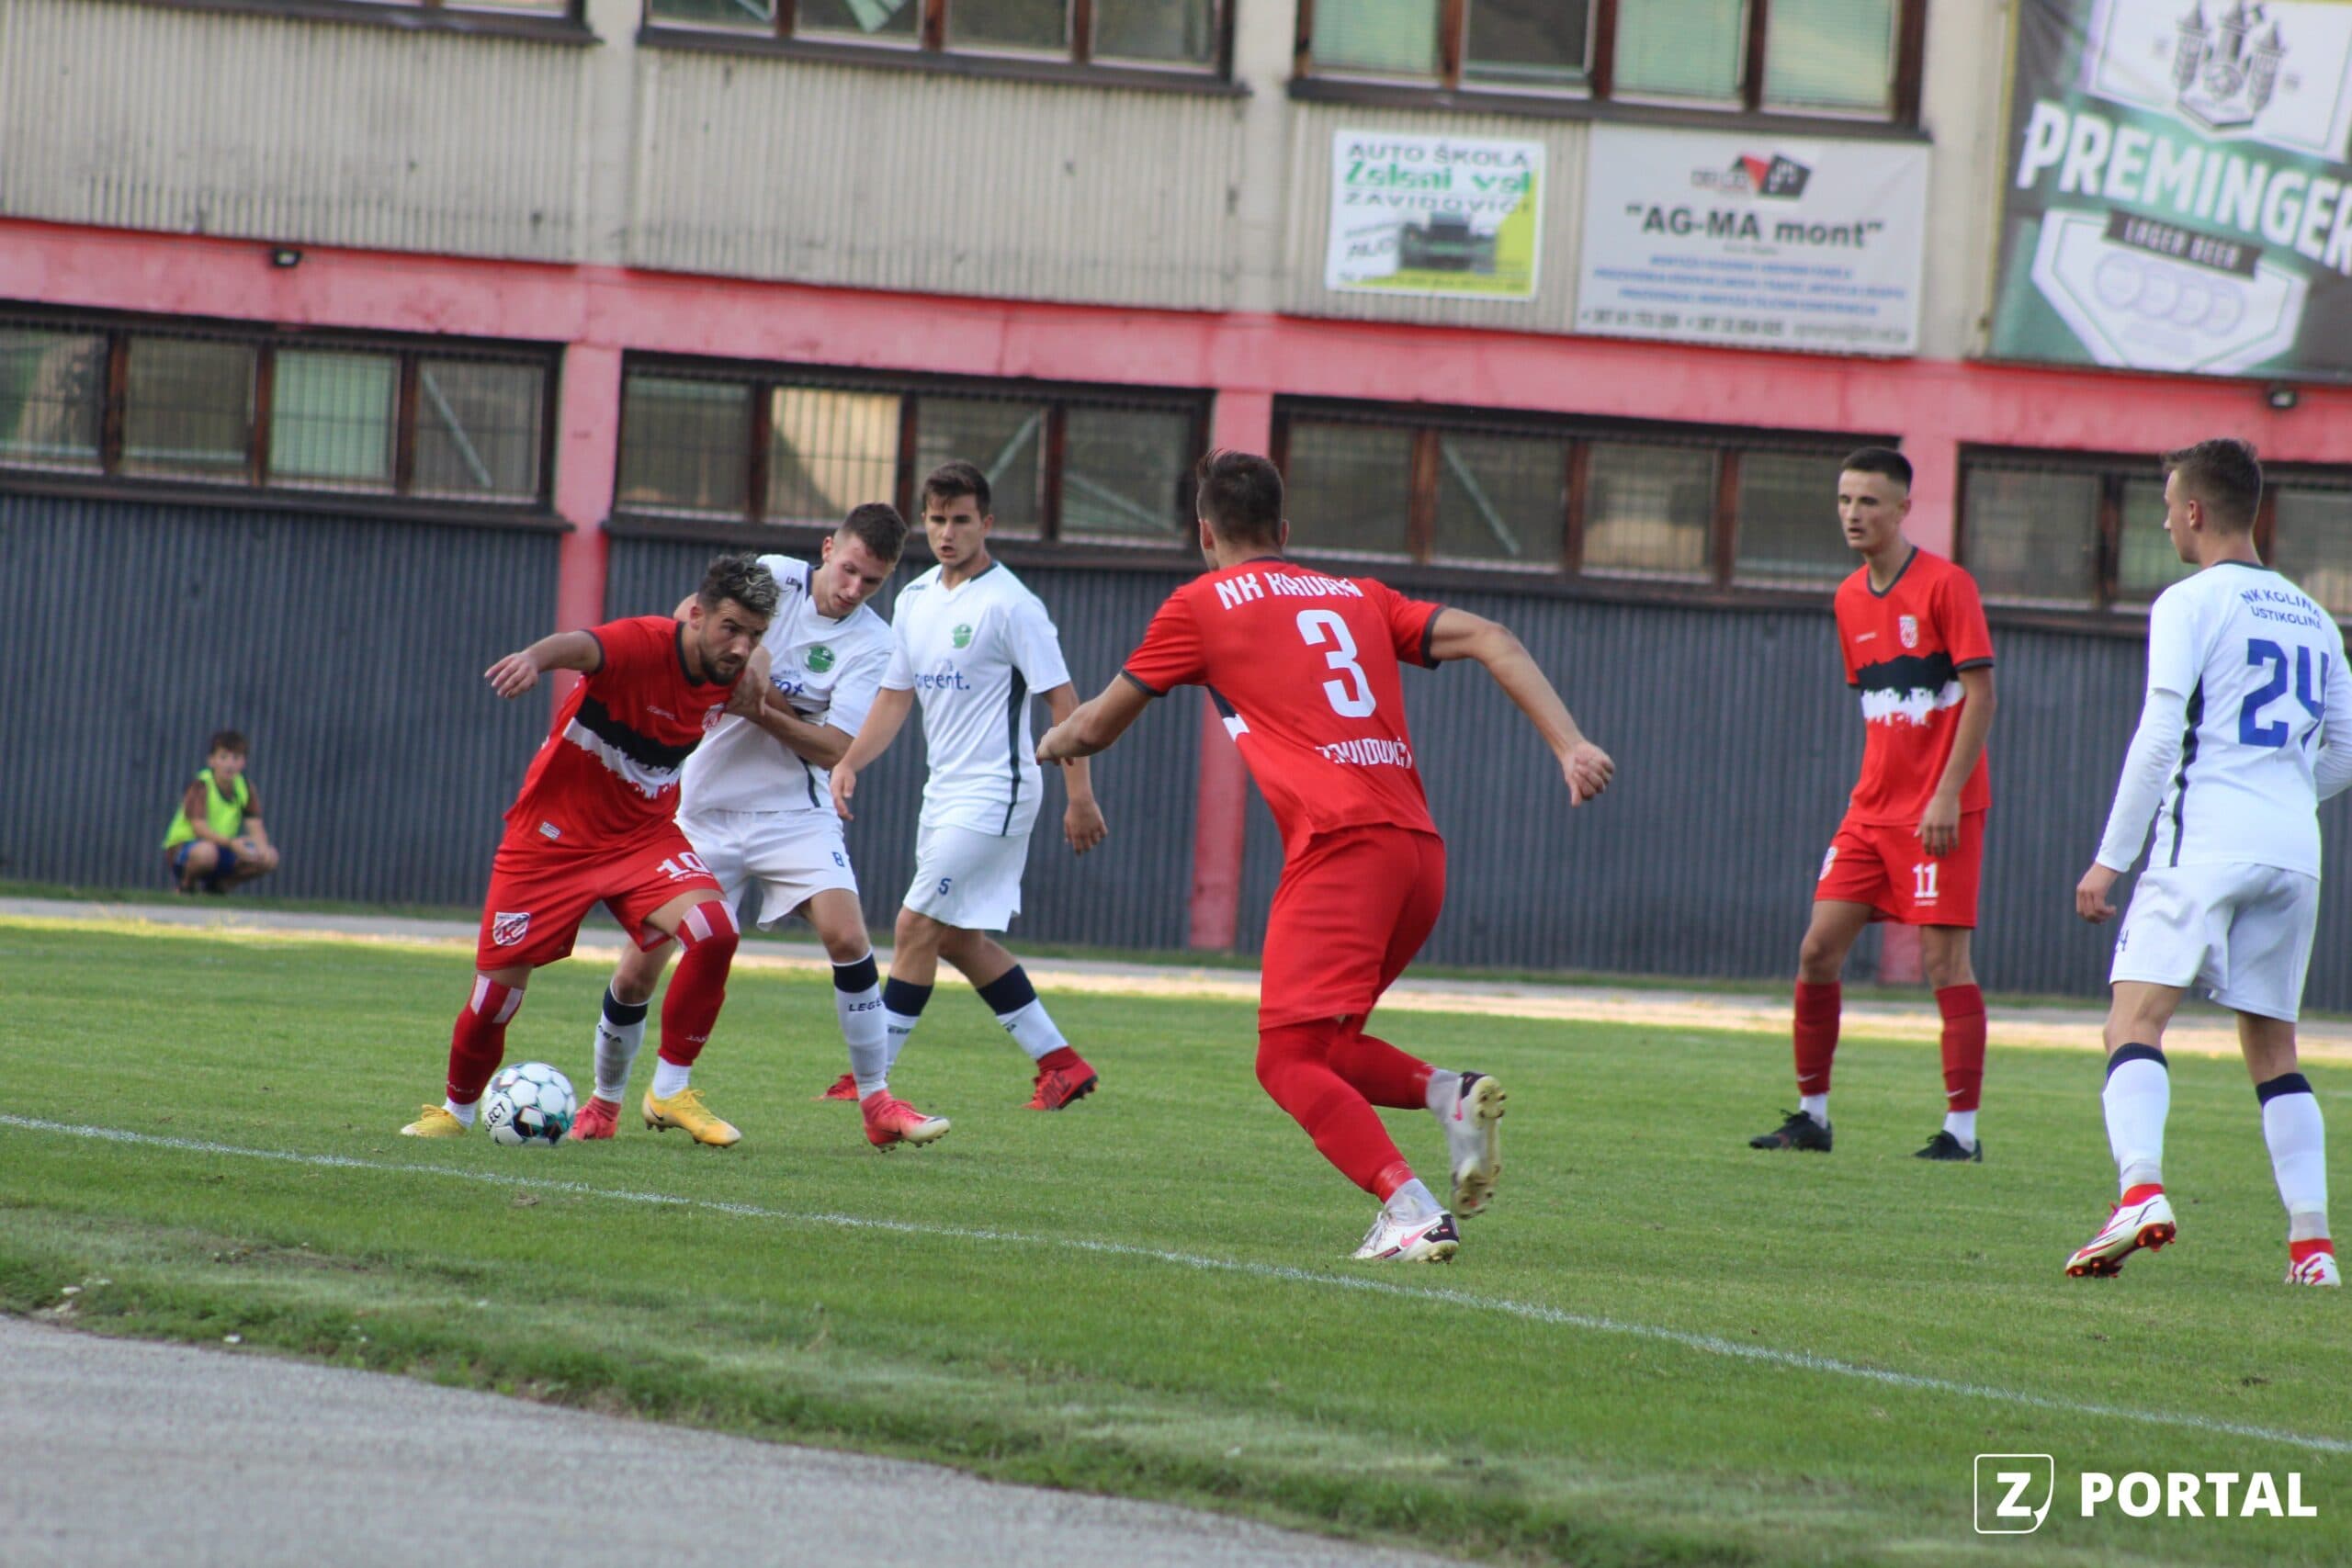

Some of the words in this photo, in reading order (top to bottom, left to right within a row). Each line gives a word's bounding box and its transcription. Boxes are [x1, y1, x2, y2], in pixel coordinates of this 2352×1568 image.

[1348, 143, 1426, 163] AUTO
[1433, 143, 1529, 167] ŠKOLA
[2124, 218, 2186, 254] LAGER
[2190, 237, 2241, 270] BEER
[1214, 573, 1265, 611] NK
[2240, 589, 2263, 605] NK
[1296, 609, 1377, 718] 3
[2238, 638, 2329, 752] 24
[656, 852, 712, 879] 10
[1912, 863, 1939, 898] 11
[938, 877, 953, 896] 5
